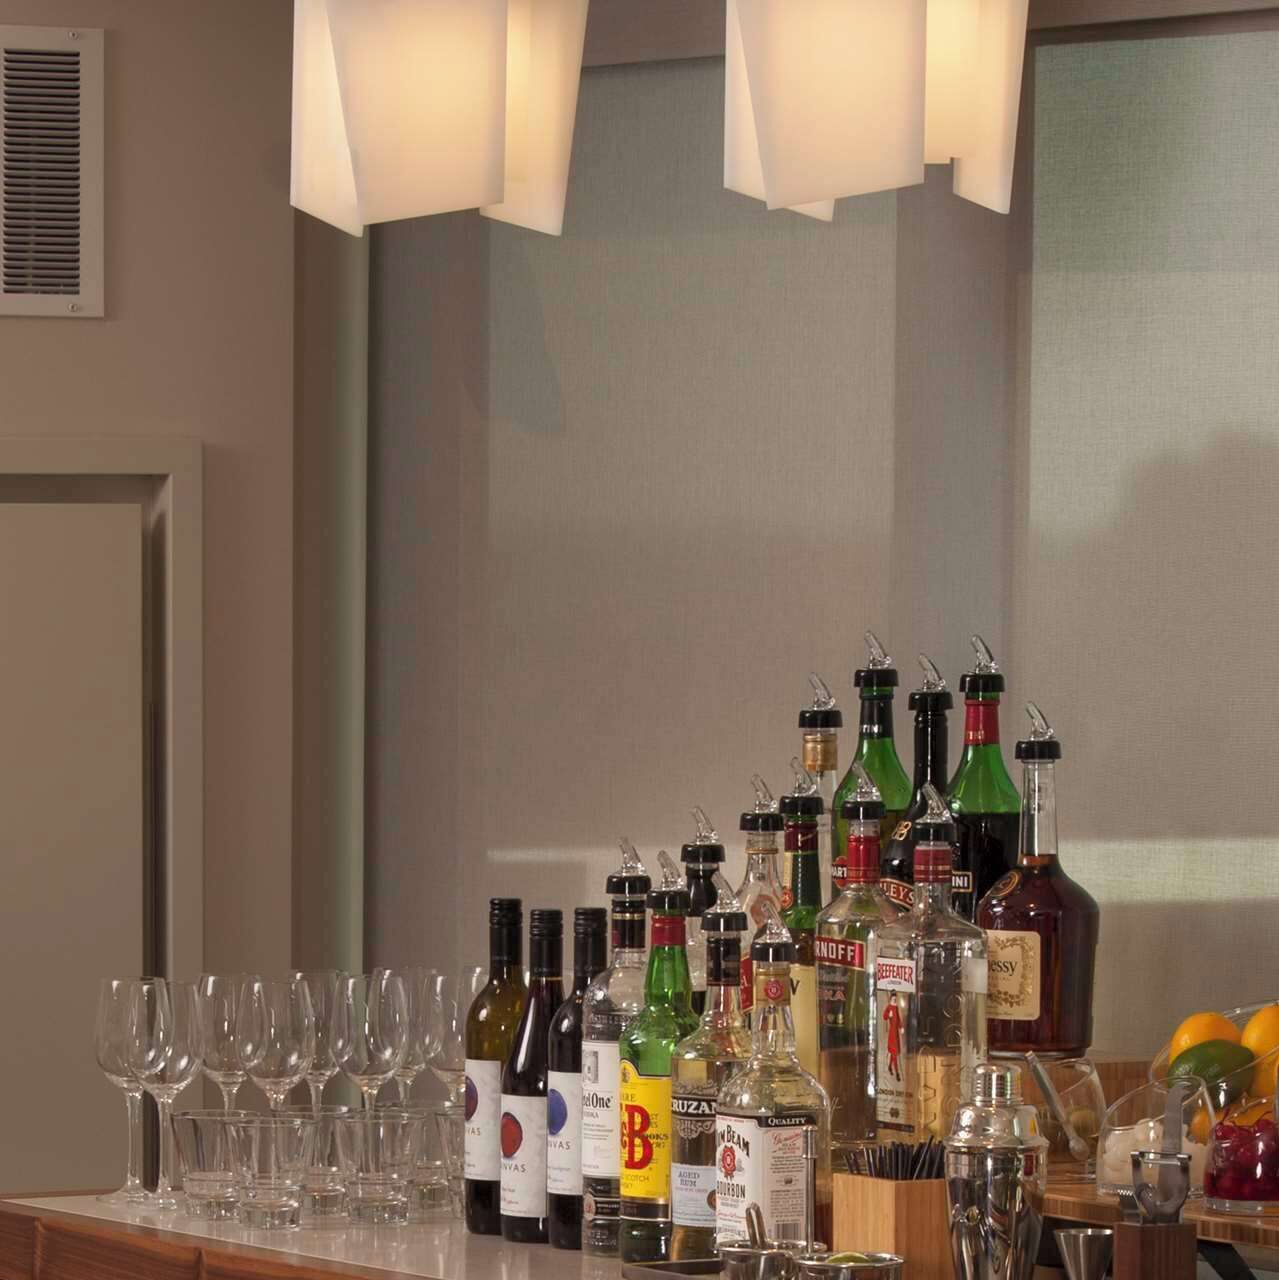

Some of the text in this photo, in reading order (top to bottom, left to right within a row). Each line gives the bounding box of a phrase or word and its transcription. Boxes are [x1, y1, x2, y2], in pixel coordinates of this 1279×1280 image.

[877, 963, 914, 985] BEEFEATER
[592, 1092, 611, 1109] One
[768, 1117, 806, 1126] QUALITY
[727, 1124, 750, 1158] BEAM
